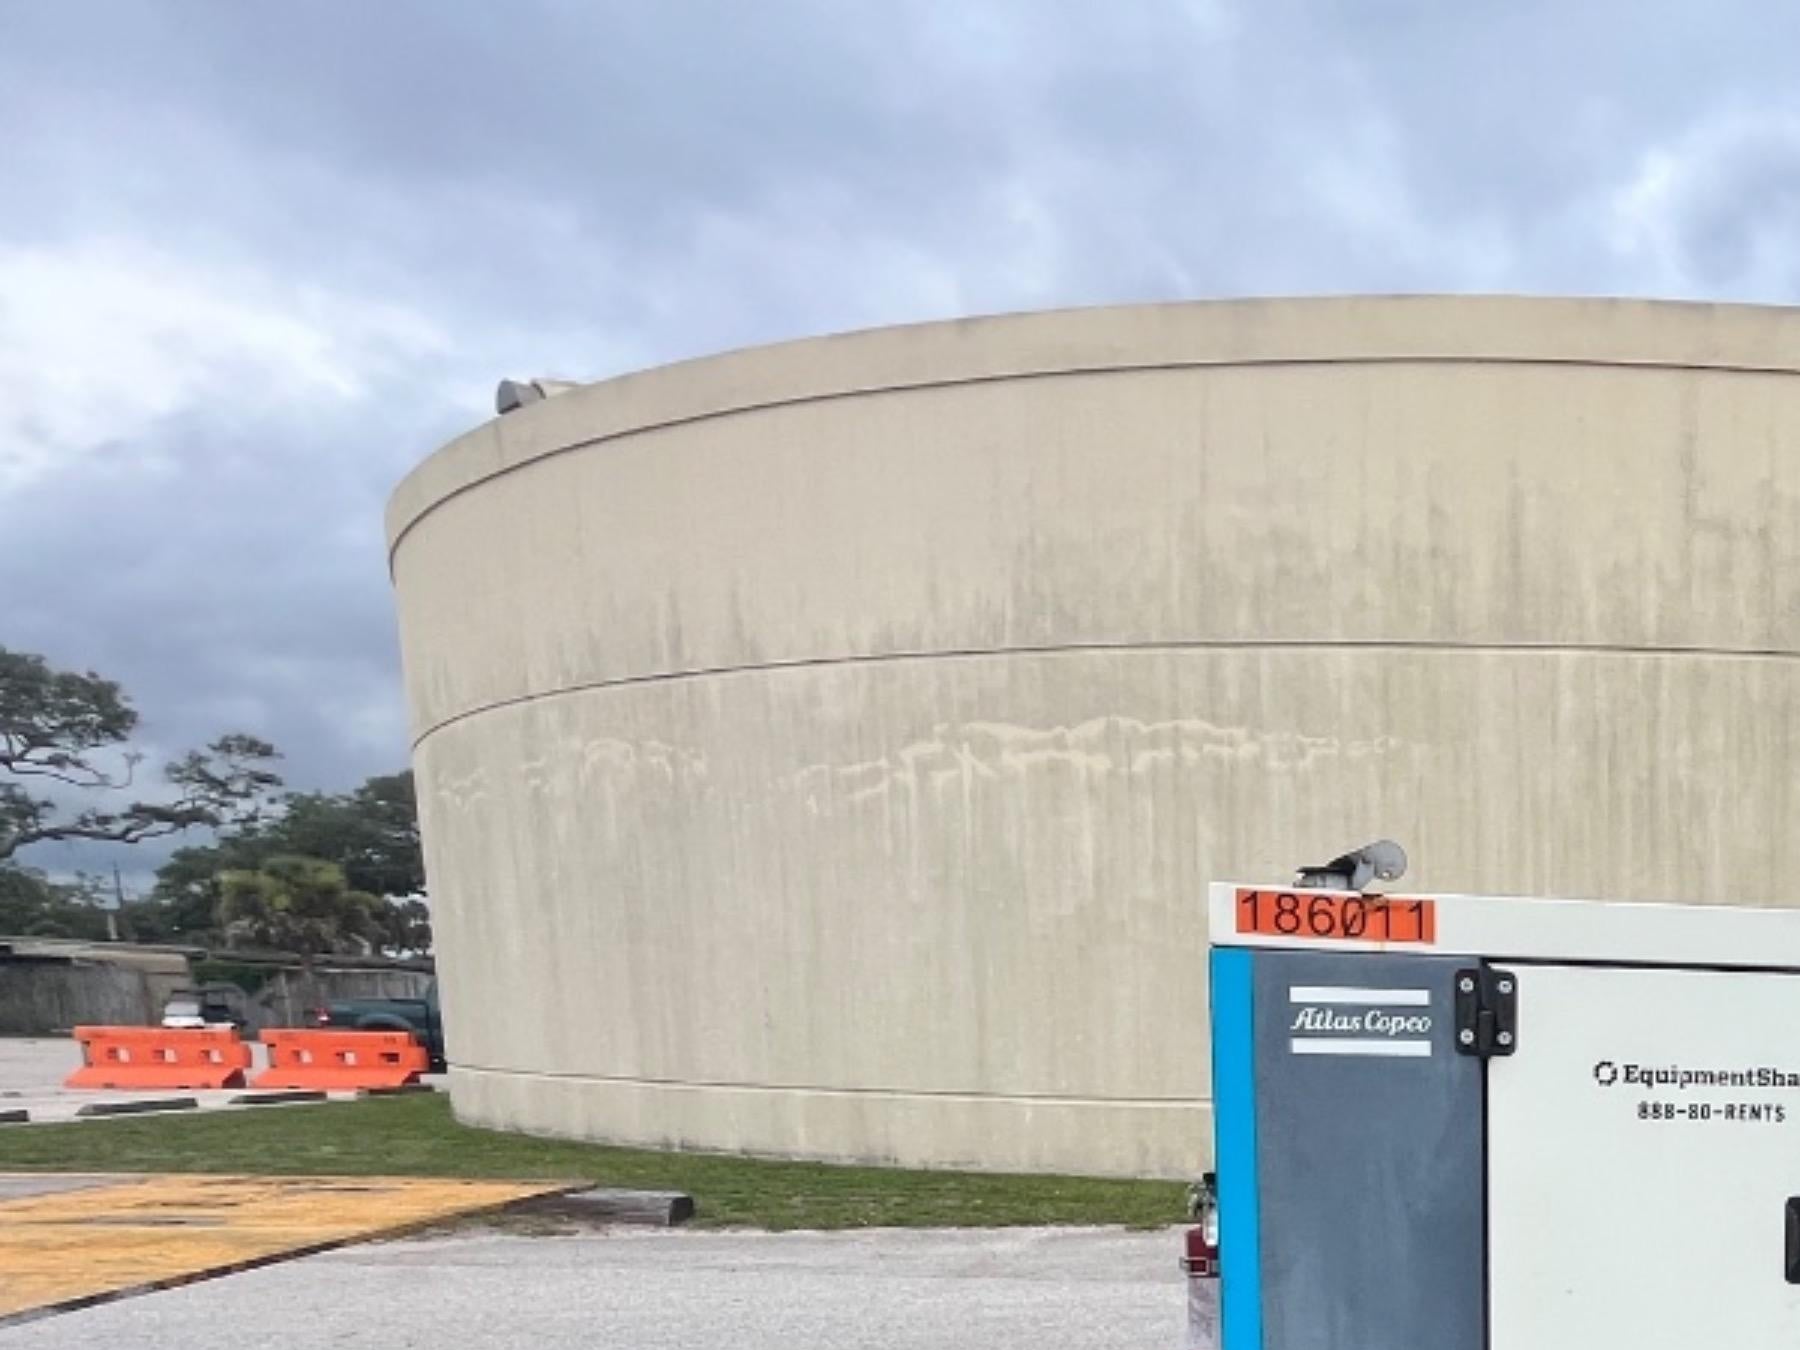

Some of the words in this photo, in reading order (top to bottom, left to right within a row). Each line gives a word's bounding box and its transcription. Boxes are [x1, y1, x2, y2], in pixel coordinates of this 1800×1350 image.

[1241, 891, 1424, 940] 186011
[1290, 1007, 1361, 1032] Atlas
[1364, 1011, 1432, 1036] Copco
[1637, 1100, 1786, 1123] 888-80-RENTS
